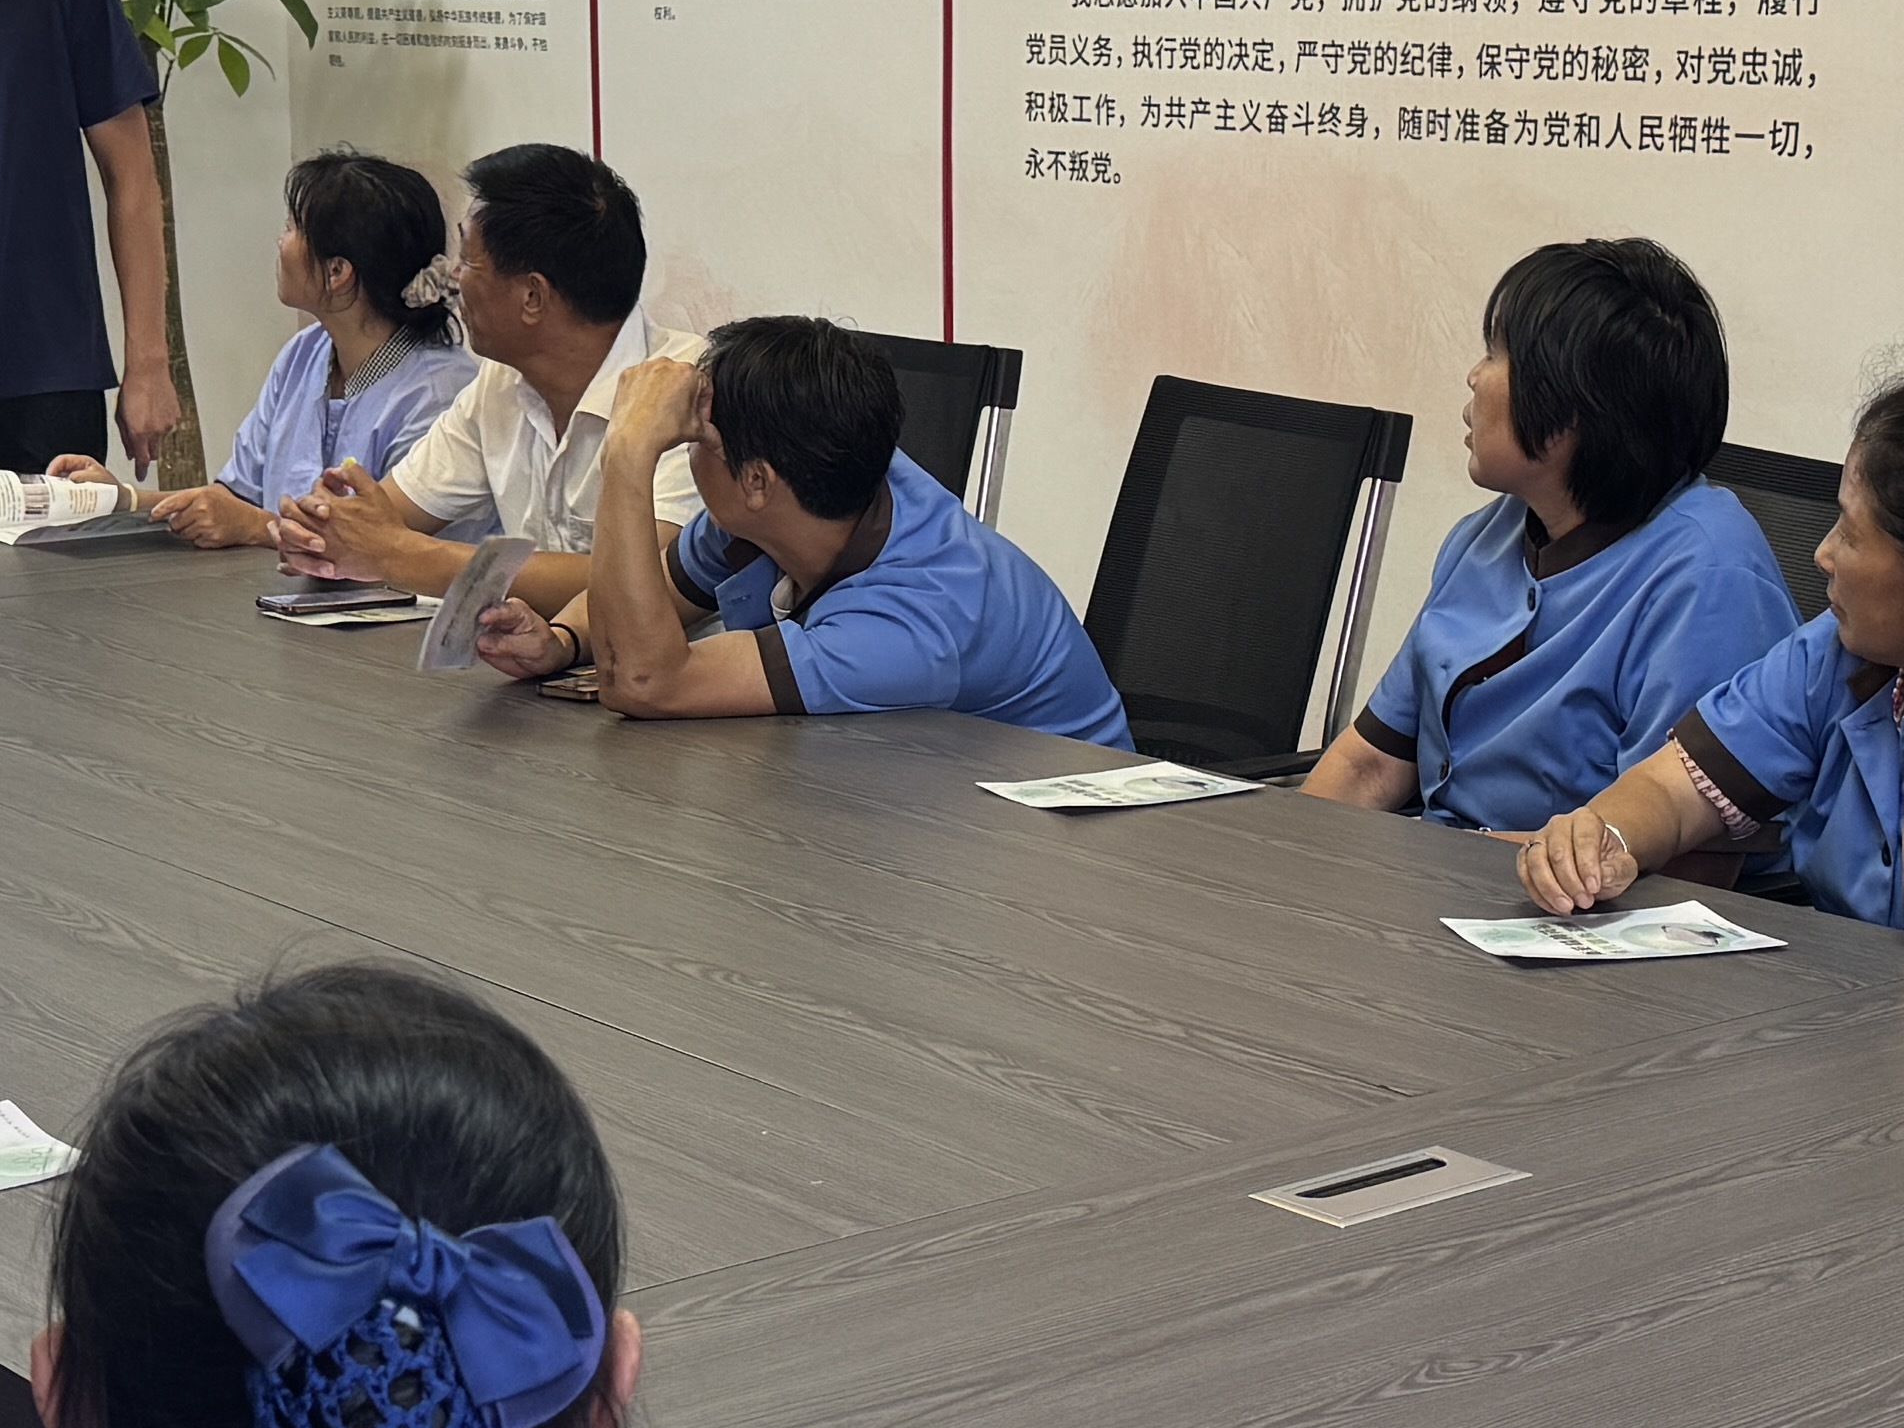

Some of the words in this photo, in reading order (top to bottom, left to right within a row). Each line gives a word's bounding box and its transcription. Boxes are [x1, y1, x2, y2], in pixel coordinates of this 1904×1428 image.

[1024, 33, 1819, 92] 党员义务，执行党的决定，严守党的纪律，保守党的秘密，对党忠诚，
[1023, 90, 1816, 161] 积极工作，为共产主义奋斗终身，随时准备为党和人民牺牲一切，
[1023, 148, 1126, 185] 永不叛党。
